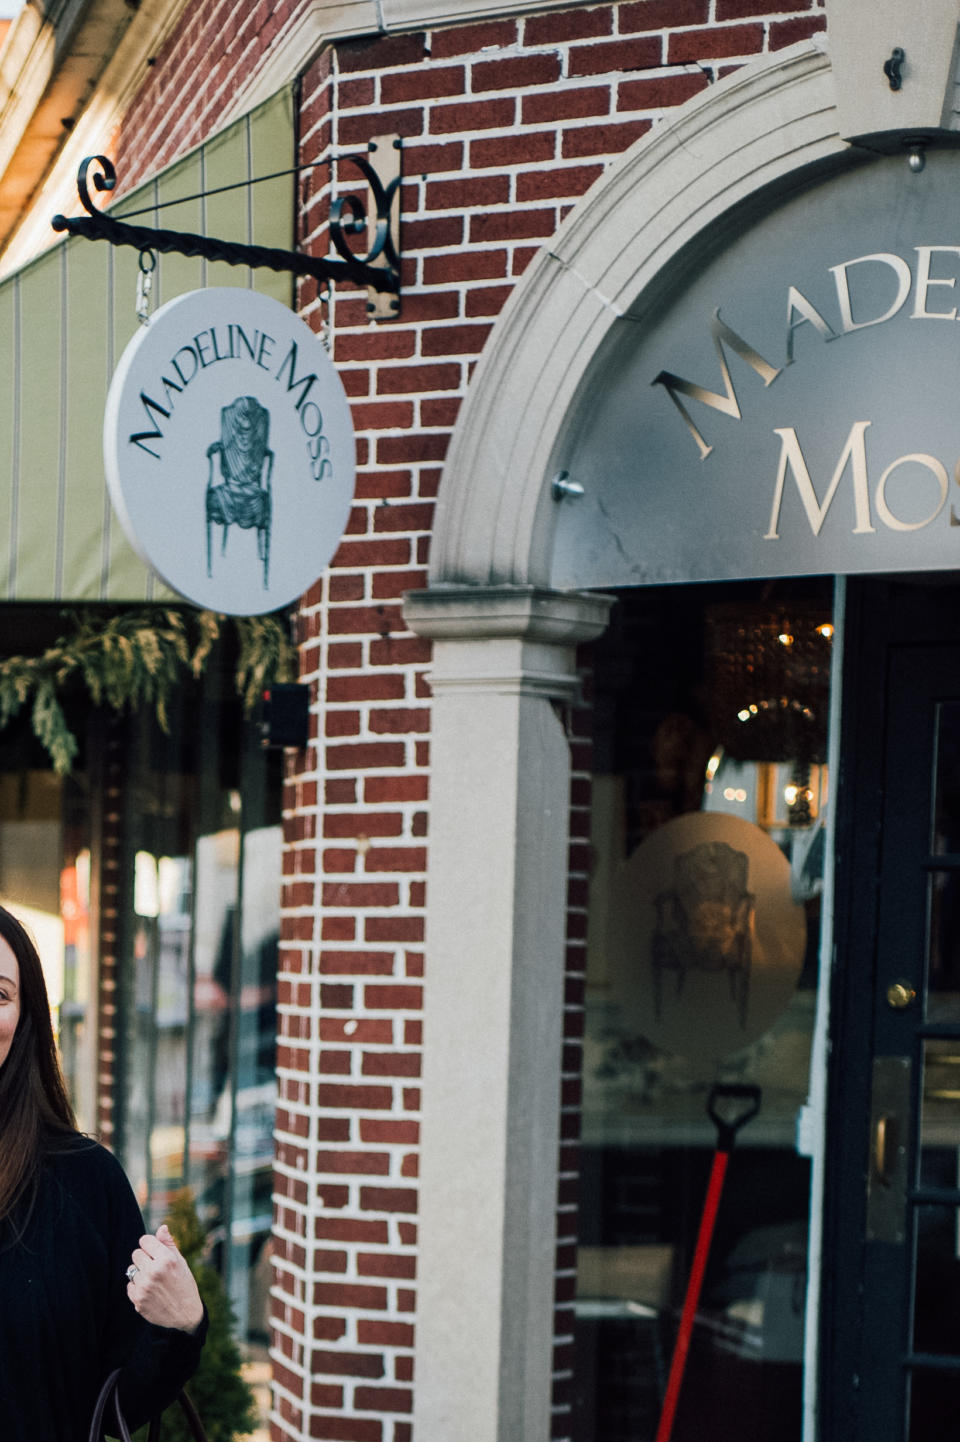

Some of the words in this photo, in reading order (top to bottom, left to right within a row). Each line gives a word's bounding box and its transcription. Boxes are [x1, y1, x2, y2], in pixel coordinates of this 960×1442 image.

[129, 323, 277, 459] MADELINE
[274, 339, 333, 481] MOSS
[650, 246, 960, 460] MADE
[763, 420, 960, 540] MO
